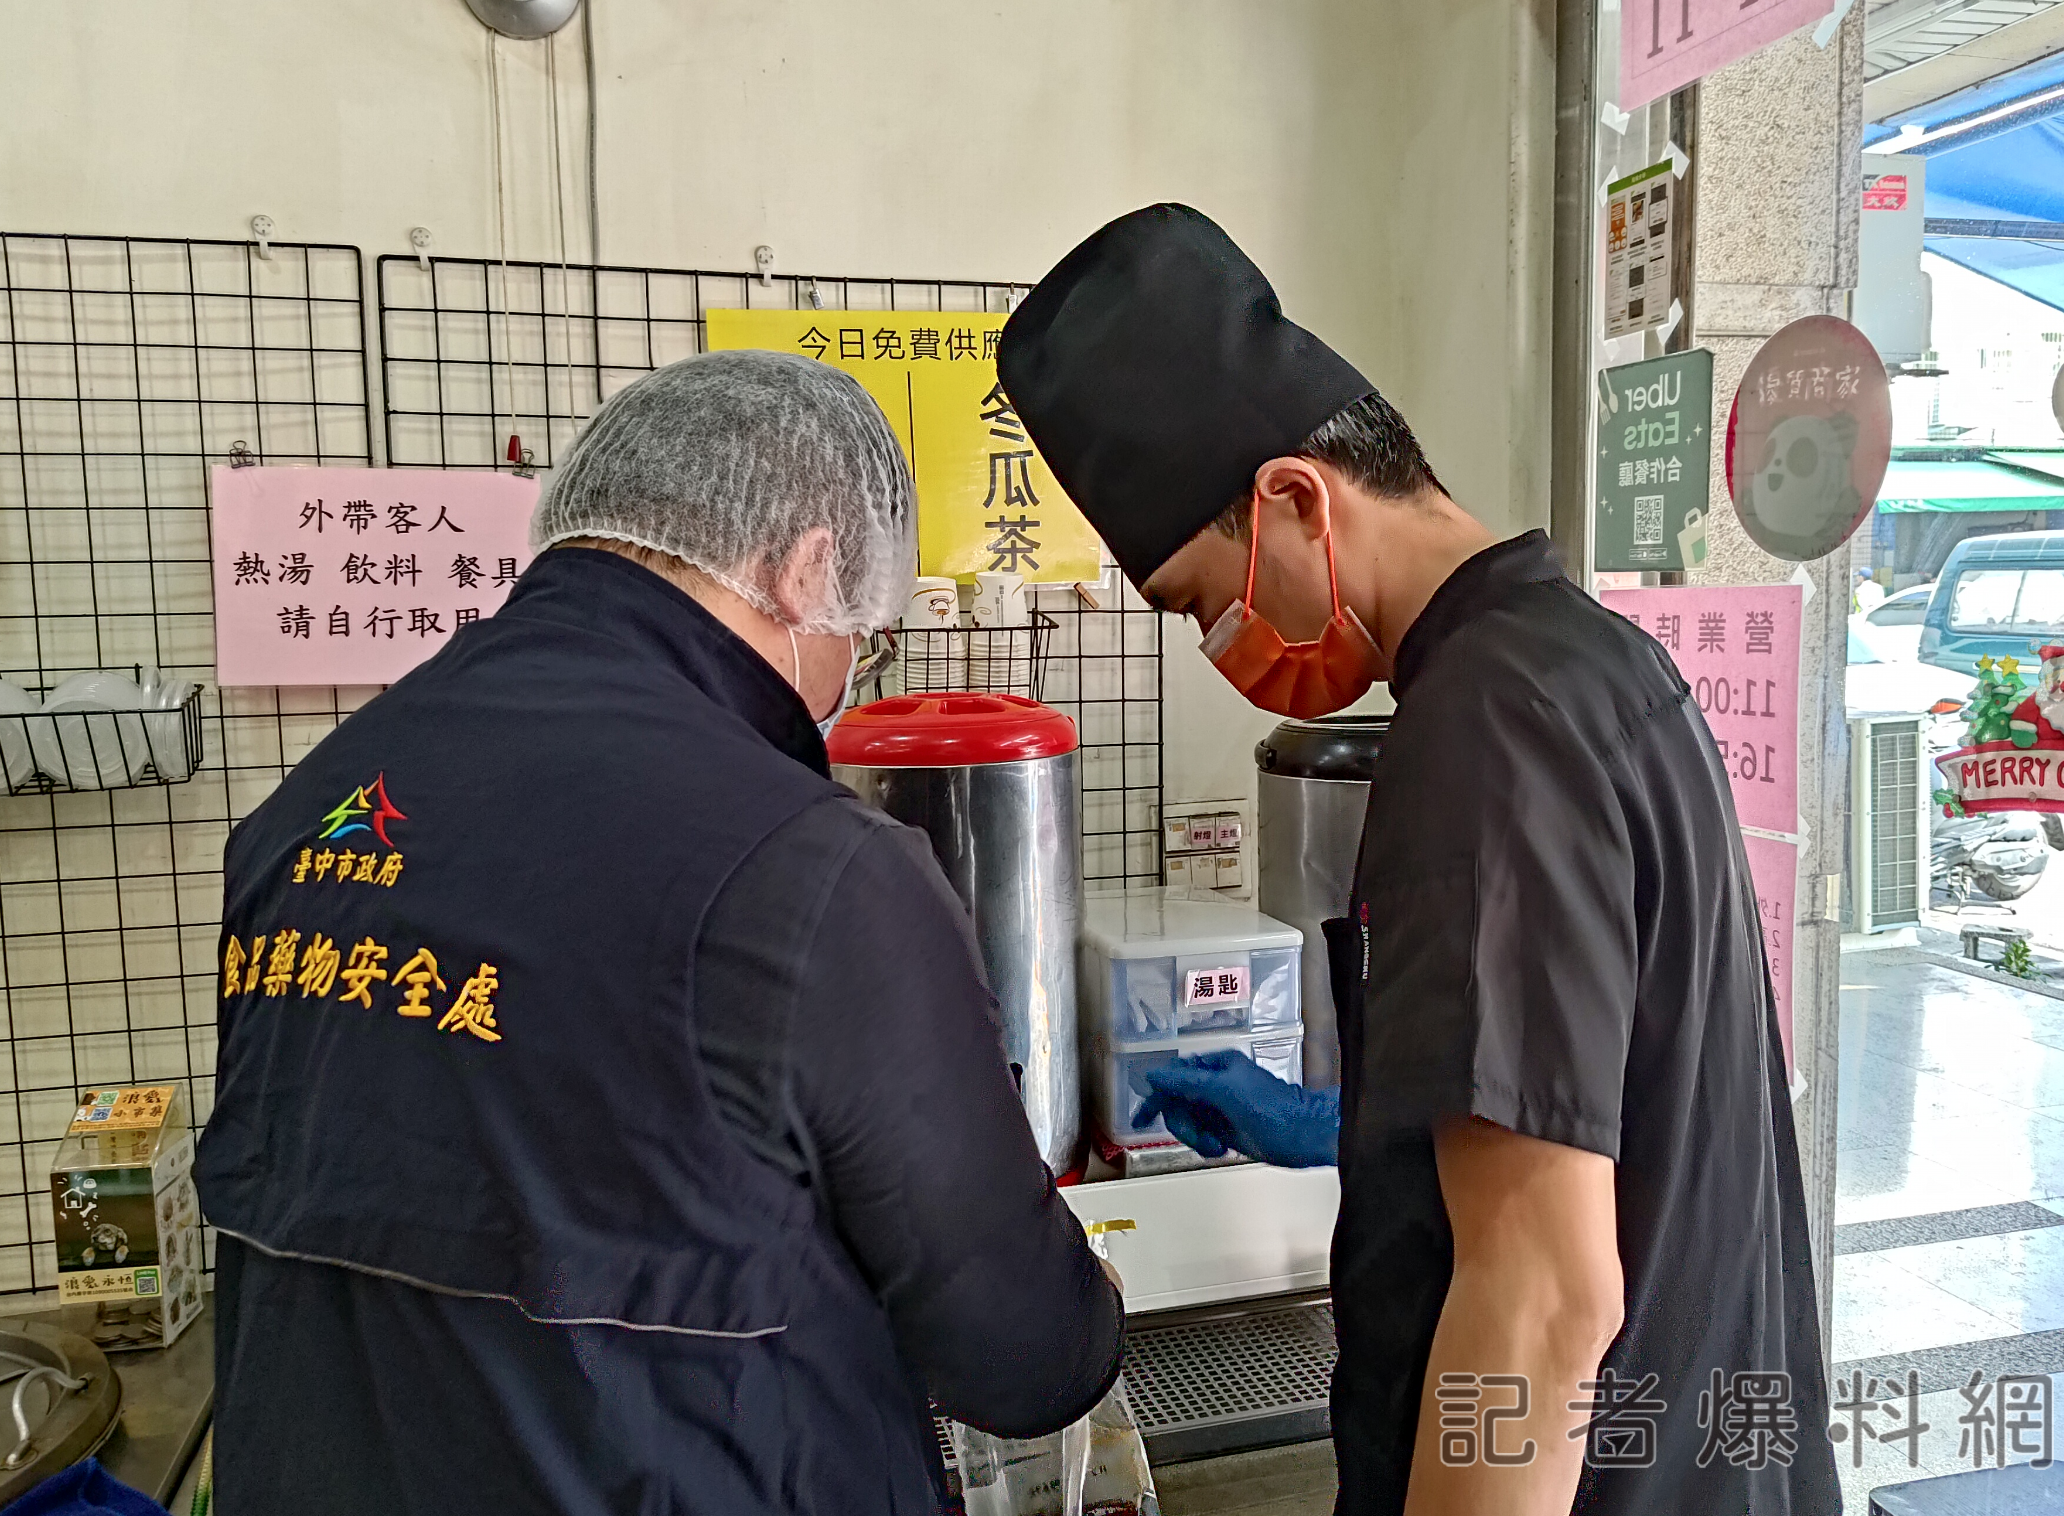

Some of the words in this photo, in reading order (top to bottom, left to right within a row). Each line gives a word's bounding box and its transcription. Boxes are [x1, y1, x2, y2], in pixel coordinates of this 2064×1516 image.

[979, 382, 1041, 572] 冬瓜茶
[298, 499, 465, 535] 外帶客人
[233, 551, 315, 586] 熱湯
[339, 552, 423, 587] 飲料
[447, 553, 523, 589] 餐具
[276, 605, 482, 640] 請自行取用
[1961, 756, 2051, 789] MERRY
[292, 847, 404, 888] 臺中市政府
[223, 928, 503, 1043] 食品藥物安全處
[1193, 974, 1239, 999] 湯匙
